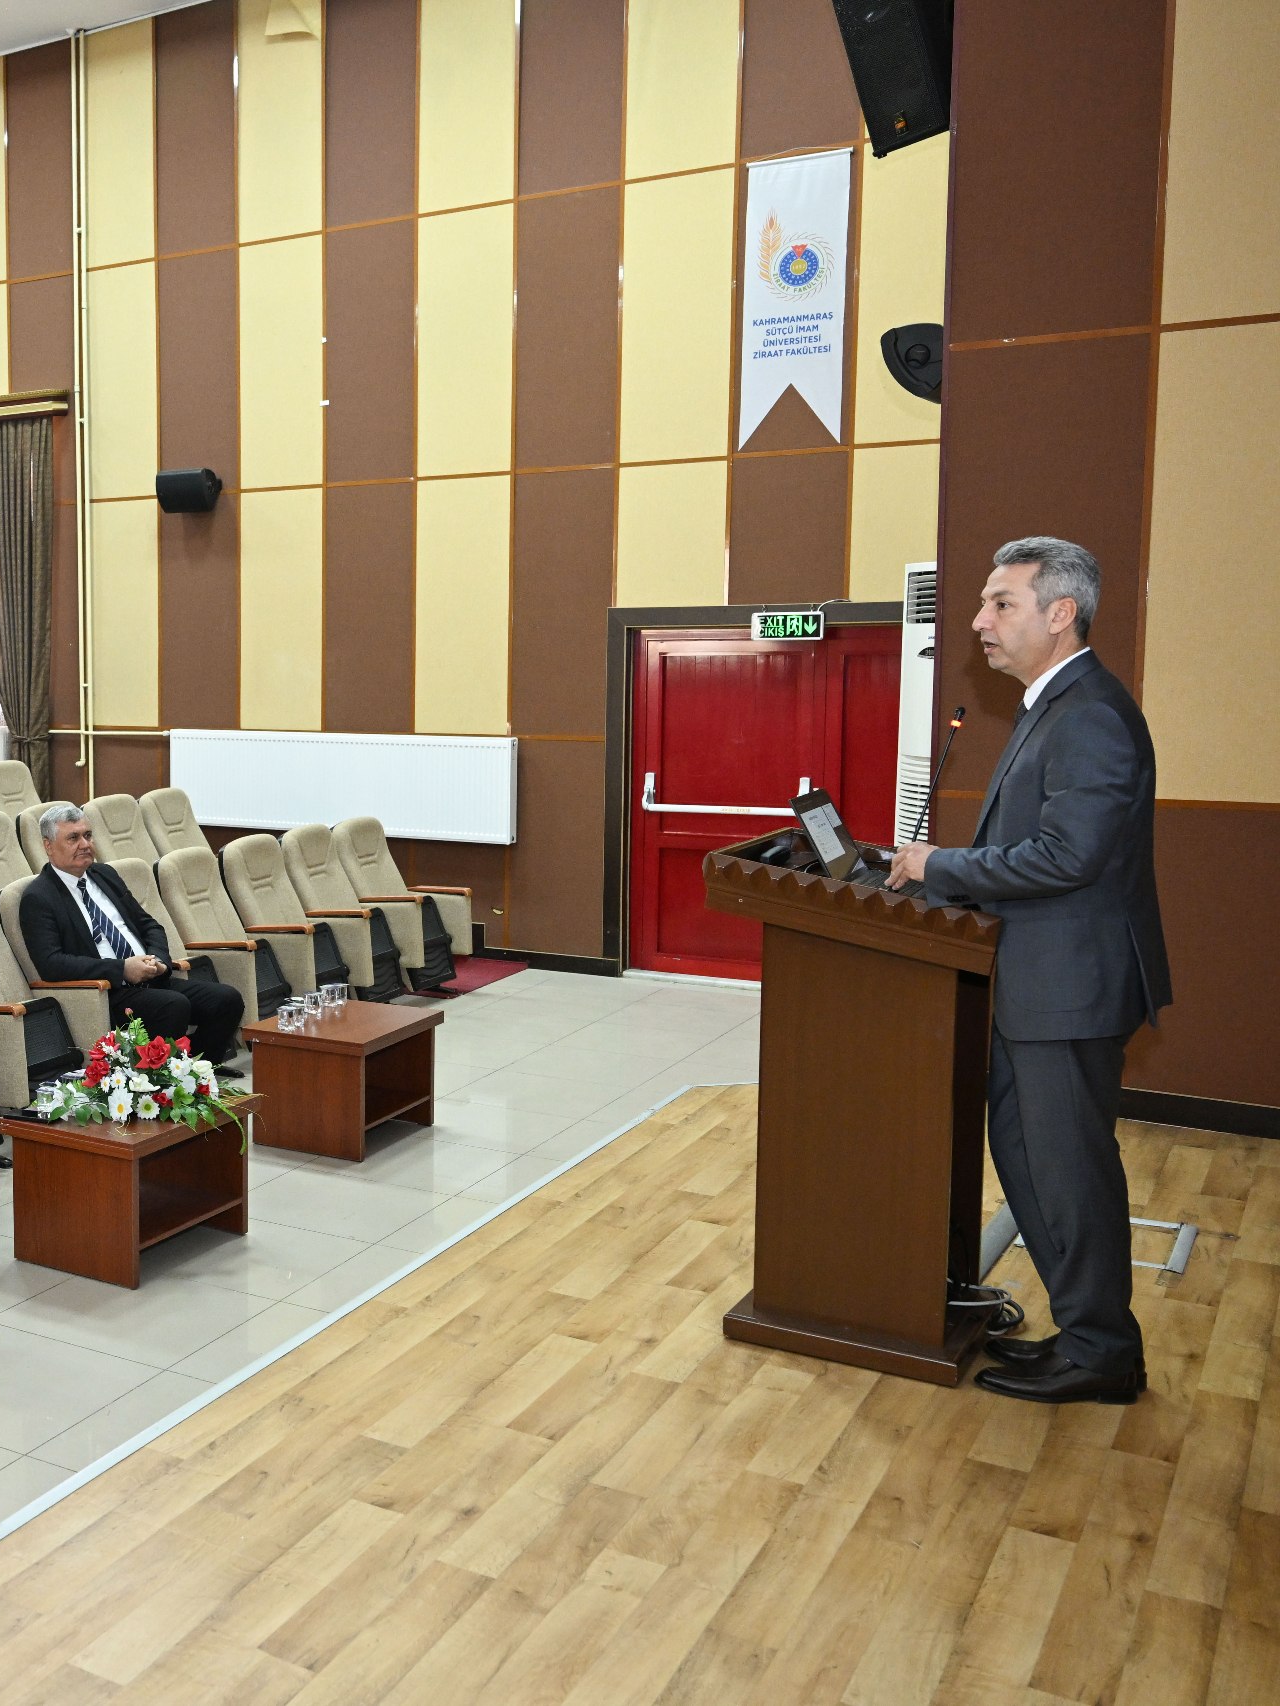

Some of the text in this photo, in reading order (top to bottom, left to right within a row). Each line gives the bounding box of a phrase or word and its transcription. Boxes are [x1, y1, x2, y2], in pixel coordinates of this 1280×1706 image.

[753, 311, 833, 326] KAHRAMANMARAŞ
[765, 324, 819, 336] SÜTÇÜ İMAM
[762, 334, 821, 347] ÜNİVERSİTESİ
[753, 344, 831, 359] ZİRAAT FAKÜLTESİ
[759, 616, 784, 627] EXIT
